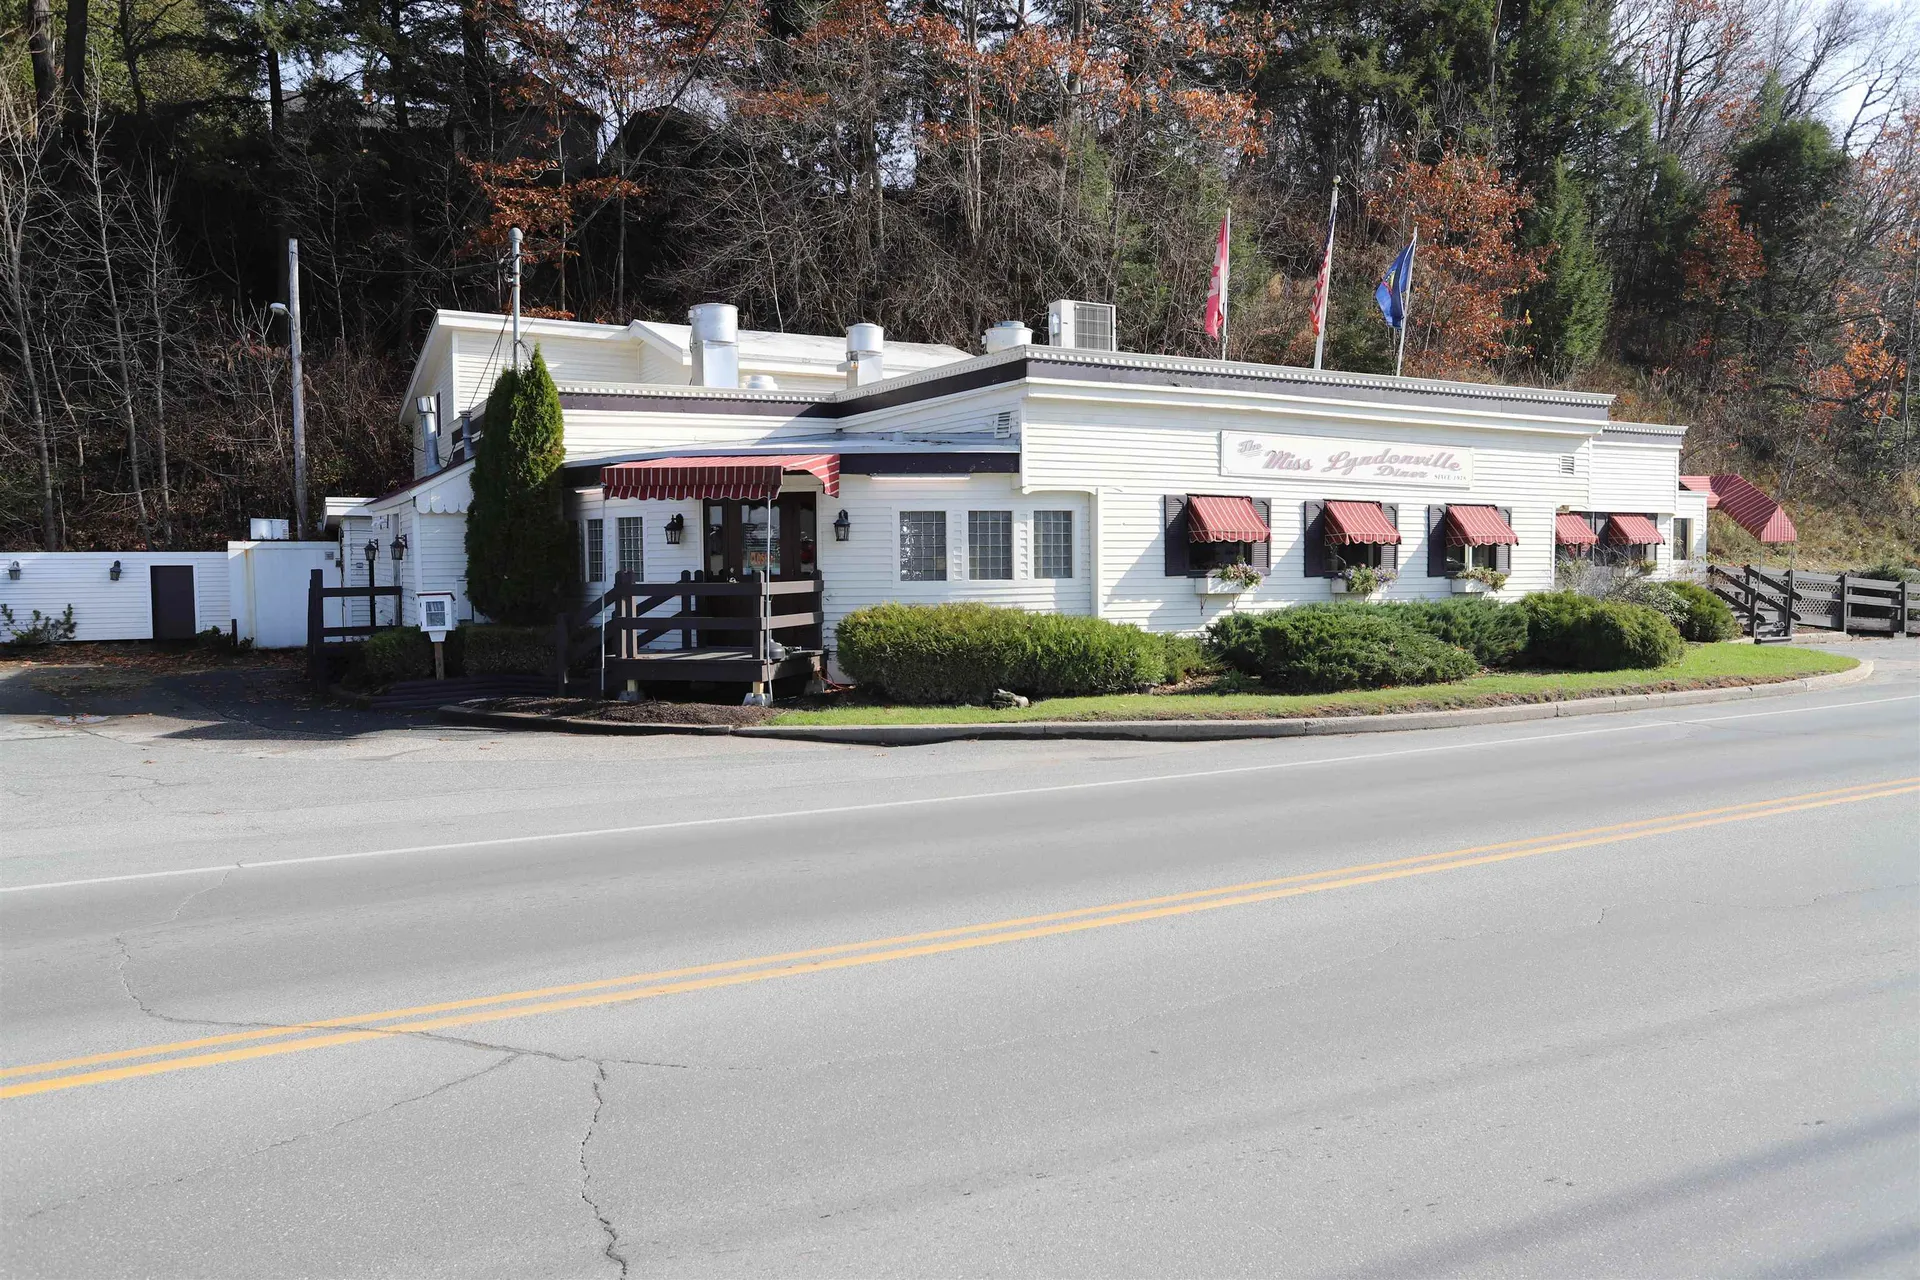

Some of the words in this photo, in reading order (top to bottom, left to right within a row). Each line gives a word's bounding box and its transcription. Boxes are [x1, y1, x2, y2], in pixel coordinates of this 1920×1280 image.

[1238, 440, 1262, 453] The
[1262, 450, 1313, 471] Miss
[1320, 448, 1462, 475] Lyndonville
[1373, 465, 1428, 479] Diner
